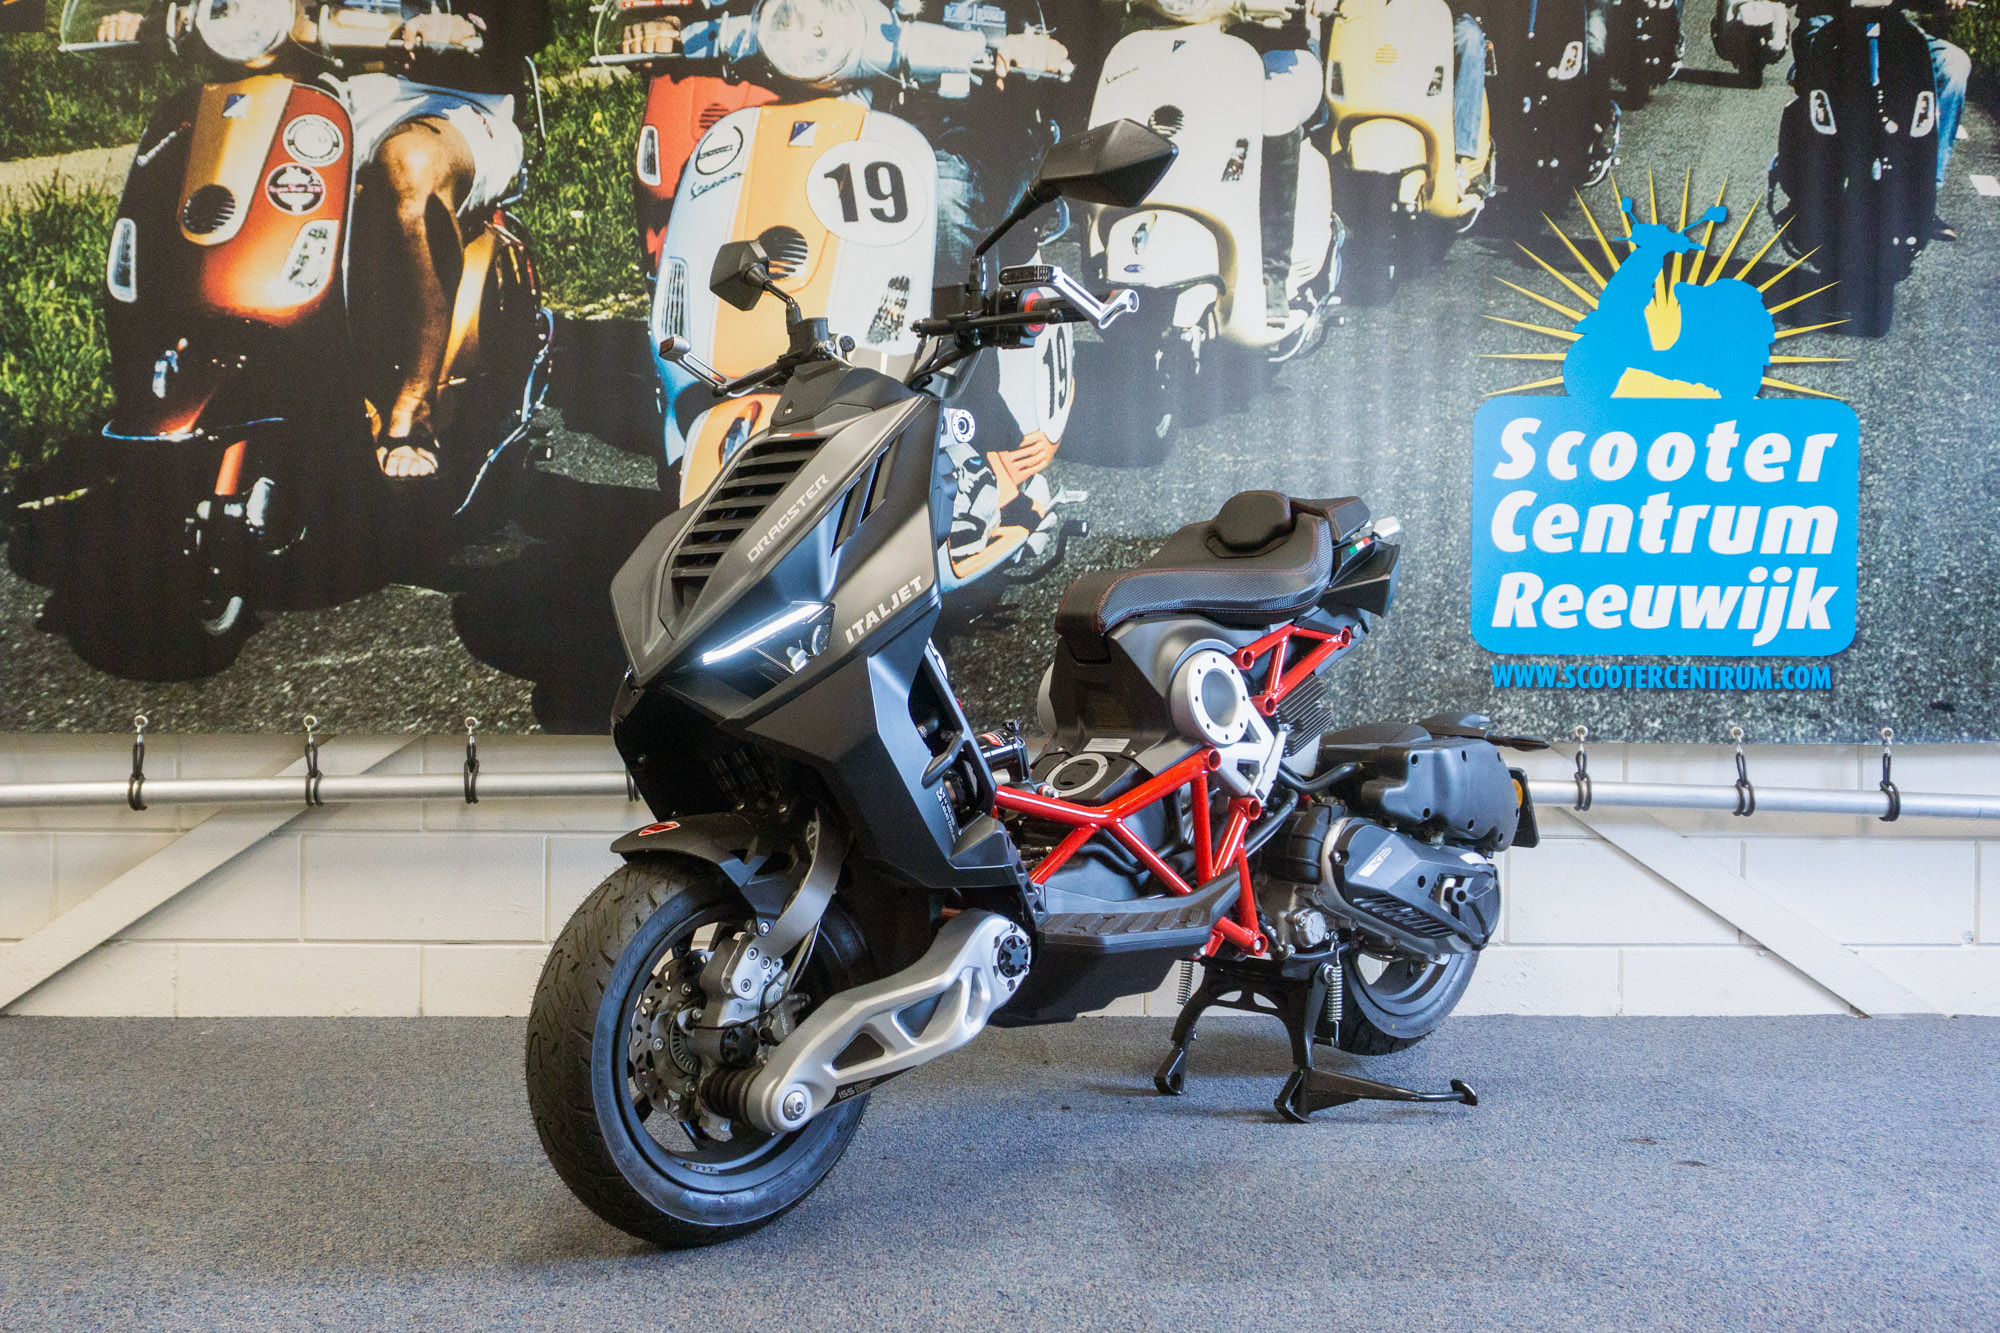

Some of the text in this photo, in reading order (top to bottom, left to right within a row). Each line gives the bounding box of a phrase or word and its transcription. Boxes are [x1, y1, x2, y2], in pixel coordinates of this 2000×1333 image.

[824, 161, 908, 223] 19
[1042, 325, 1067, 419] 19
[1492, 417, 1838, 482] Scooter
[747, 474, 829, 562] DRAGSTER
[1491, 490, 1838, 554] Centrum
[845, 575, 922, 644] ITALJET
[1491, 566, 1839, 646] Reeuwijk
[1491, 664, 1832, 690] WWW.SCOOTERCENTRUM.COM
